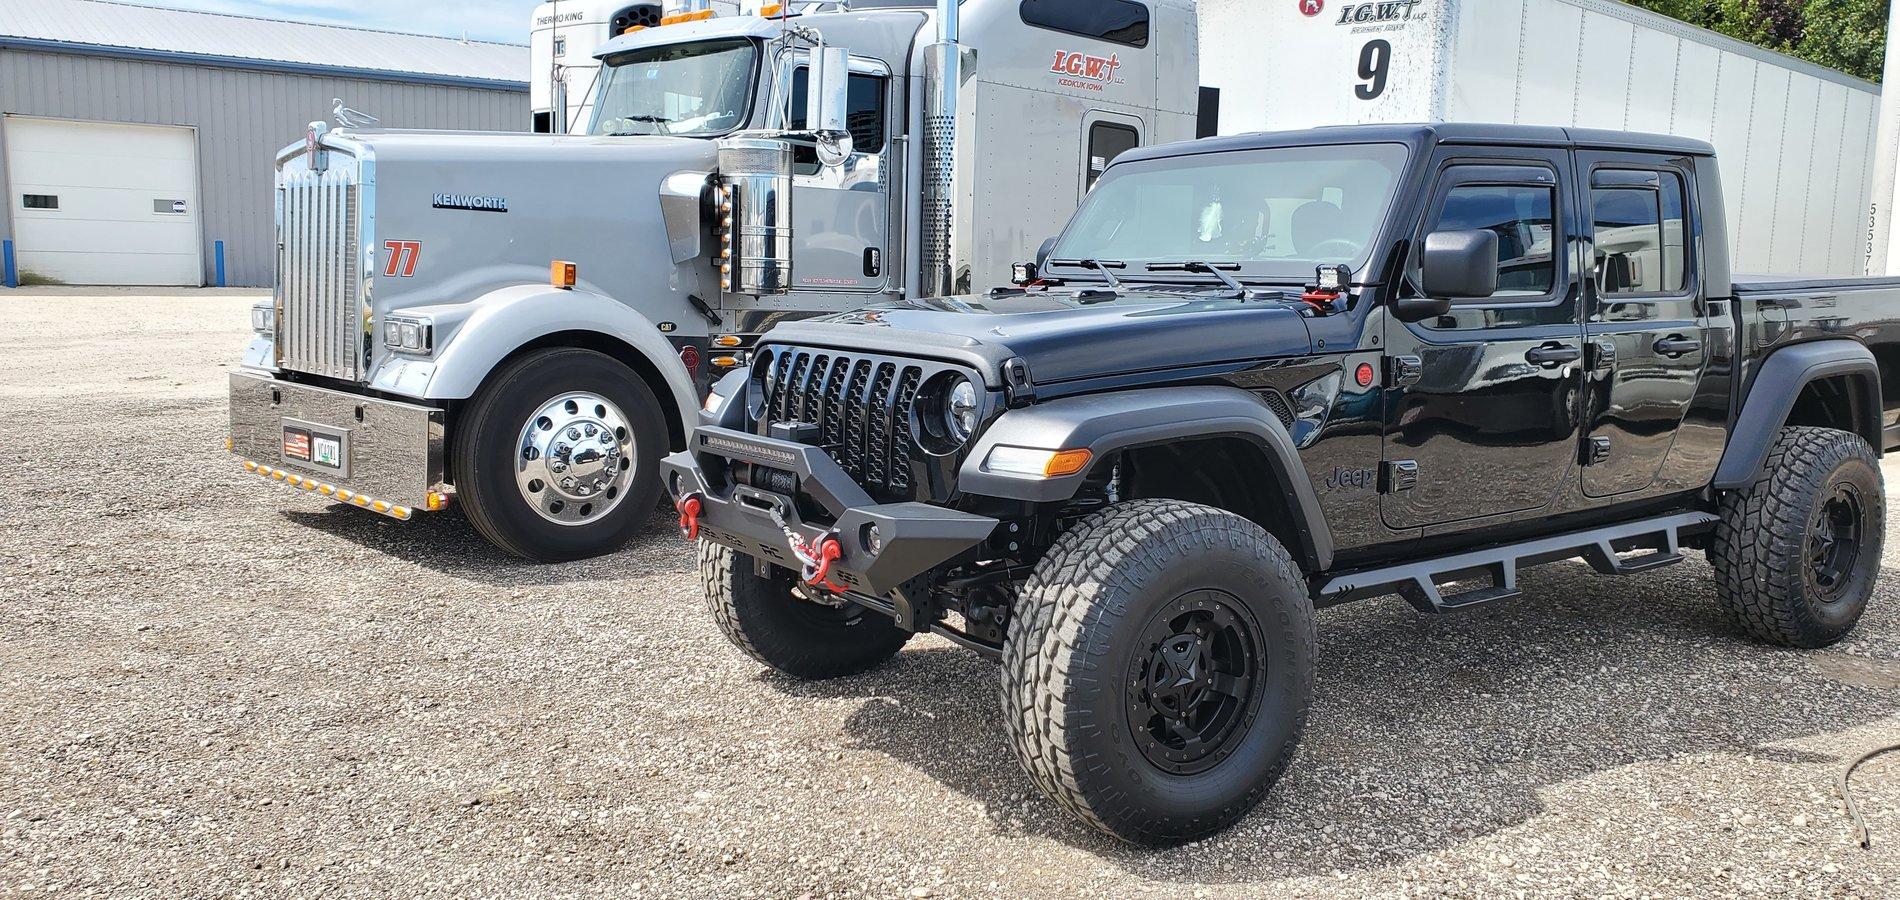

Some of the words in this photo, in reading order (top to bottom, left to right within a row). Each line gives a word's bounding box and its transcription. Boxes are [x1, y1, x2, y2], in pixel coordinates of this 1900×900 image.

[564, 11, 584, 22] KING
[1354, 38, 1392, 101] 9
[1086, 82, 1104, 92] IOWA
[433, 192, 508, 211] KENWORTH
[383, 238, 422, 277] 77
[660, 322, 673, 331] CAT
[1326, 466, 1372, 489] Jeep
